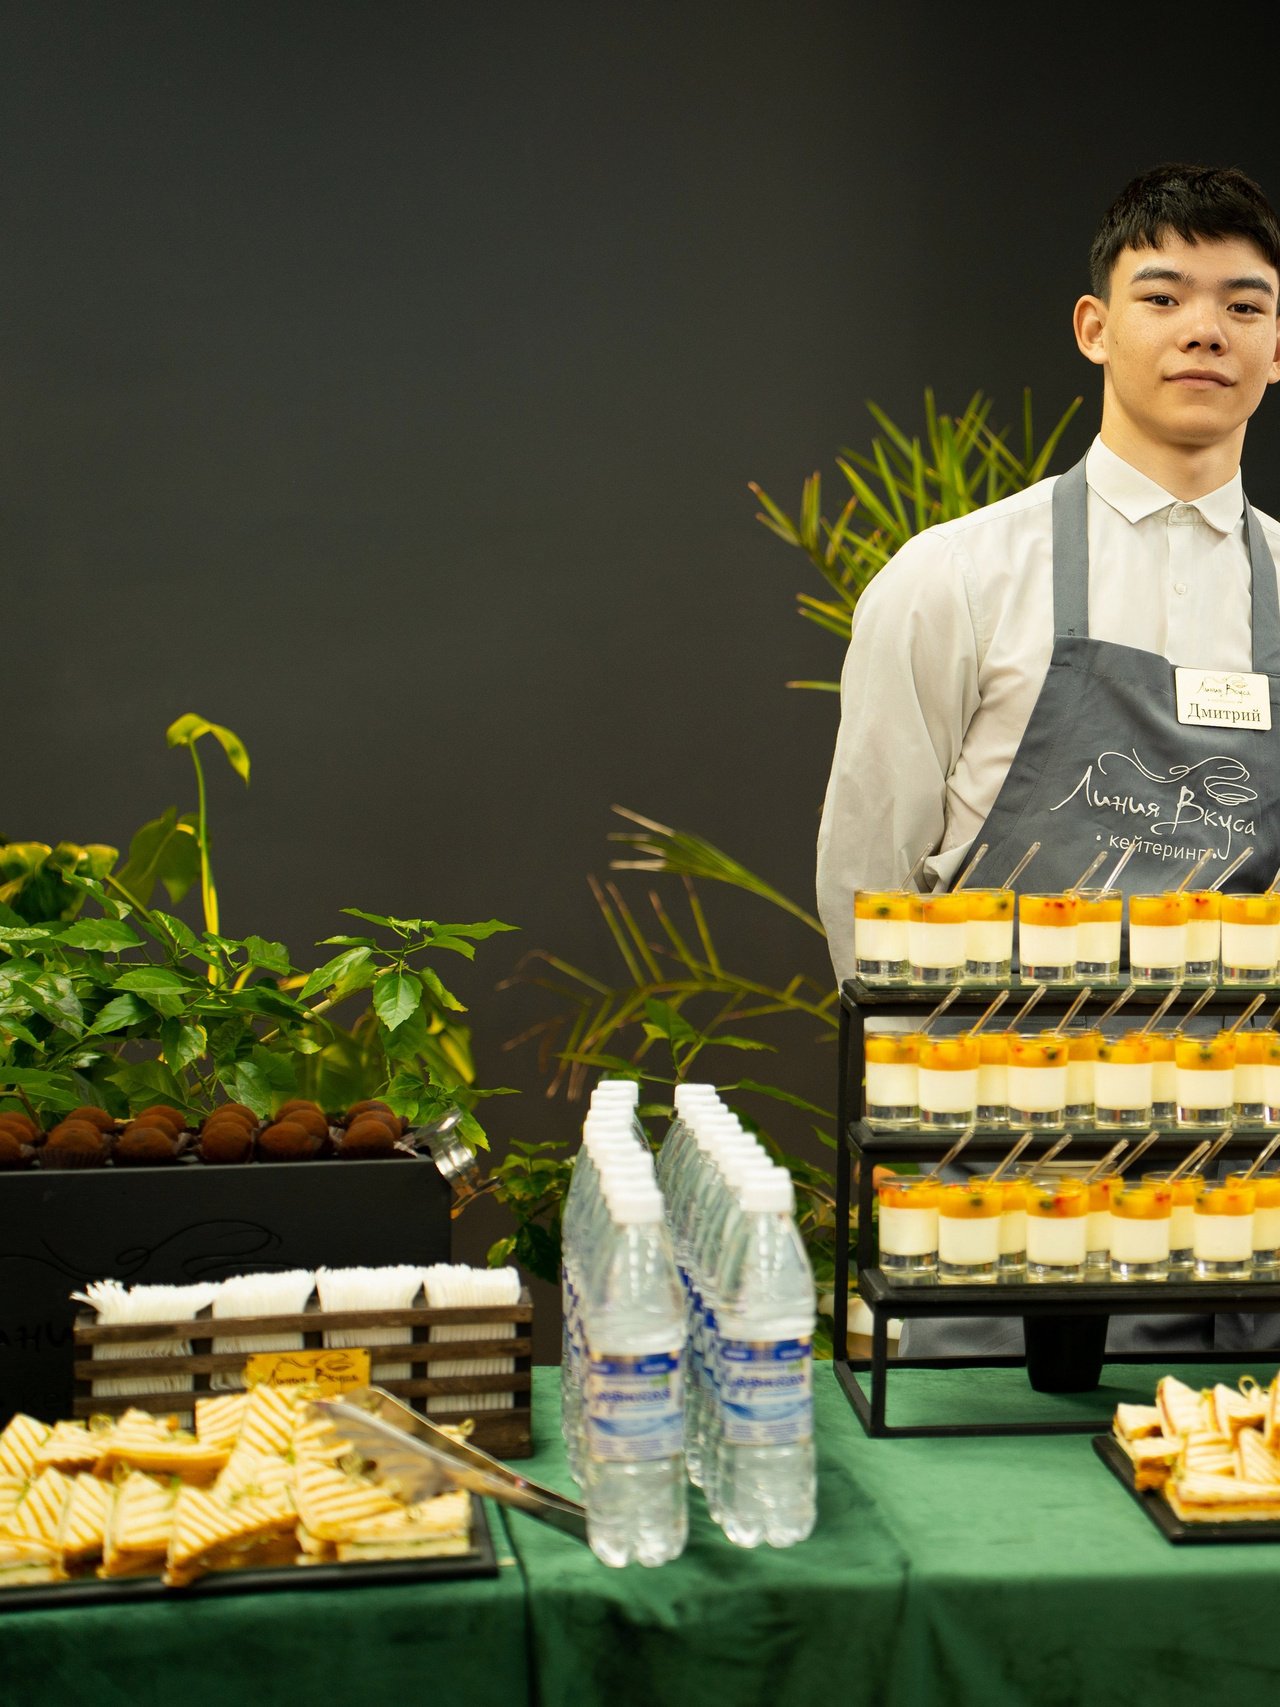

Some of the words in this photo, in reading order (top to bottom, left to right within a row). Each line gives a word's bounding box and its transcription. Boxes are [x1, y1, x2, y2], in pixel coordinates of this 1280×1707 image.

[1187, 702, 1261, 724] Дмитрий
[1050, 765, 1160, 818] Линия
[1150, 785, 1257, 861] Вкуса
[1109, 834, 1208, 861] кейтеринг
